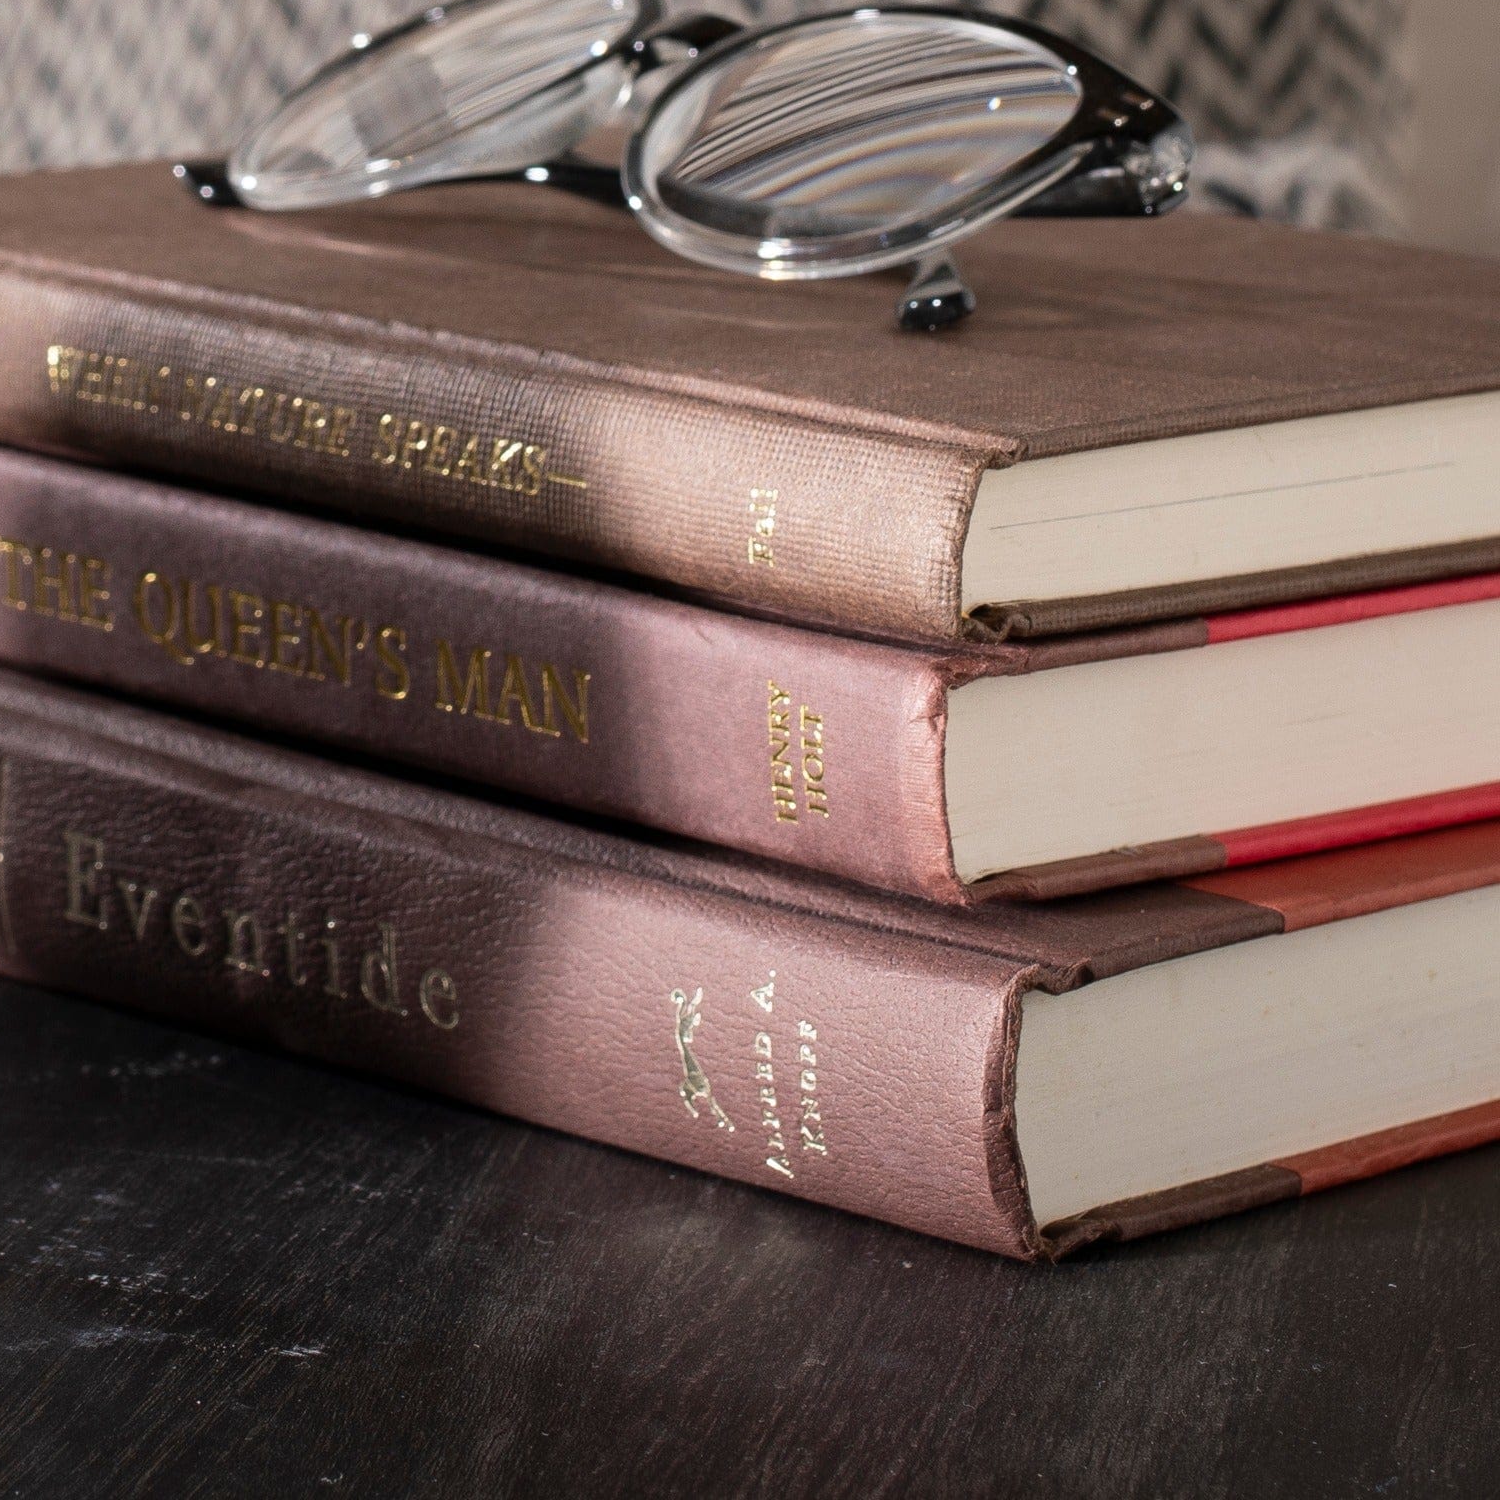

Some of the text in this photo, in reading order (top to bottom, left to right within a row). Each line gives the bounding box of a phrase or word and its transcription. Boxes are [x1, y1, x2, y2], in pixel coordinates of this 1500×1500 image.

[182, 374, 356, 457] NATURE
[135, 571, 410, 700] QUEEN'S
[435, 638, 591, 743] MAN
[768, 679, 799, 824] HENRY
[800, 705, 830, 819] HOLT
[63, 829, 460, 1031] Eventide
[750, 969, 795, 1179] ALFRED A.
[798, 1019, 828, 1156] KNOPF
